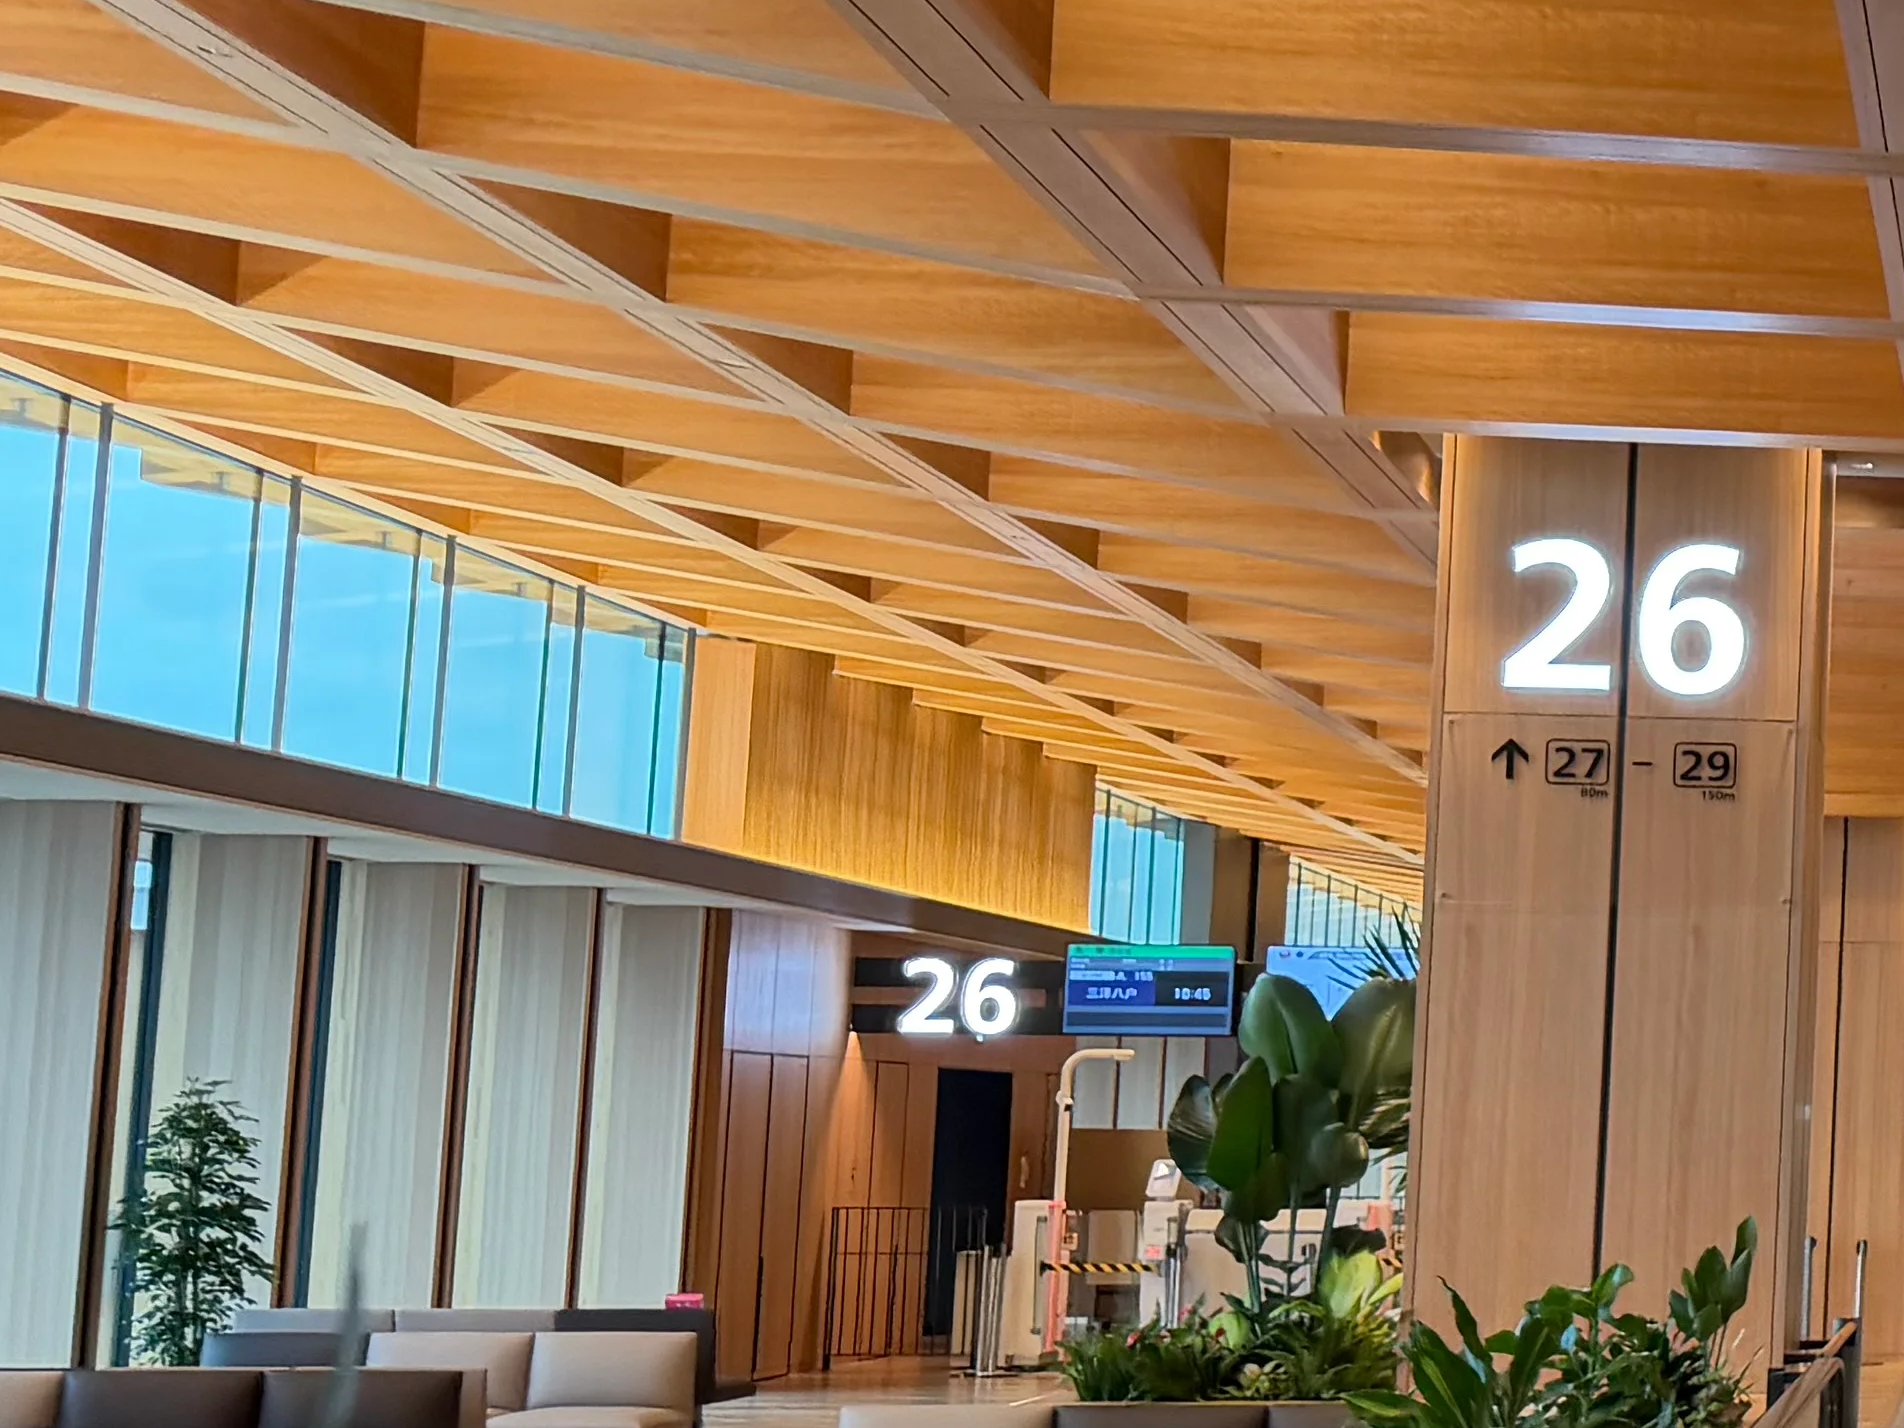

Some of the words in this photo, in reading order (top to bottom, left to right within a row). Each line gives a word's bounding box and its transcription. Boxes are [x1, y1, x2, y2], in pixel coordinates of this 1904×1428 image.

[1500, 537, 1746, 695] 26
[1552, 746, 1605, 779] 27
[1679, 749, 1731, 782] 29
[1580, 787, 1609, 799] 80m
[1701, 790, 1736, 801] 150m
[897, 957, 1021, 1035] 26
